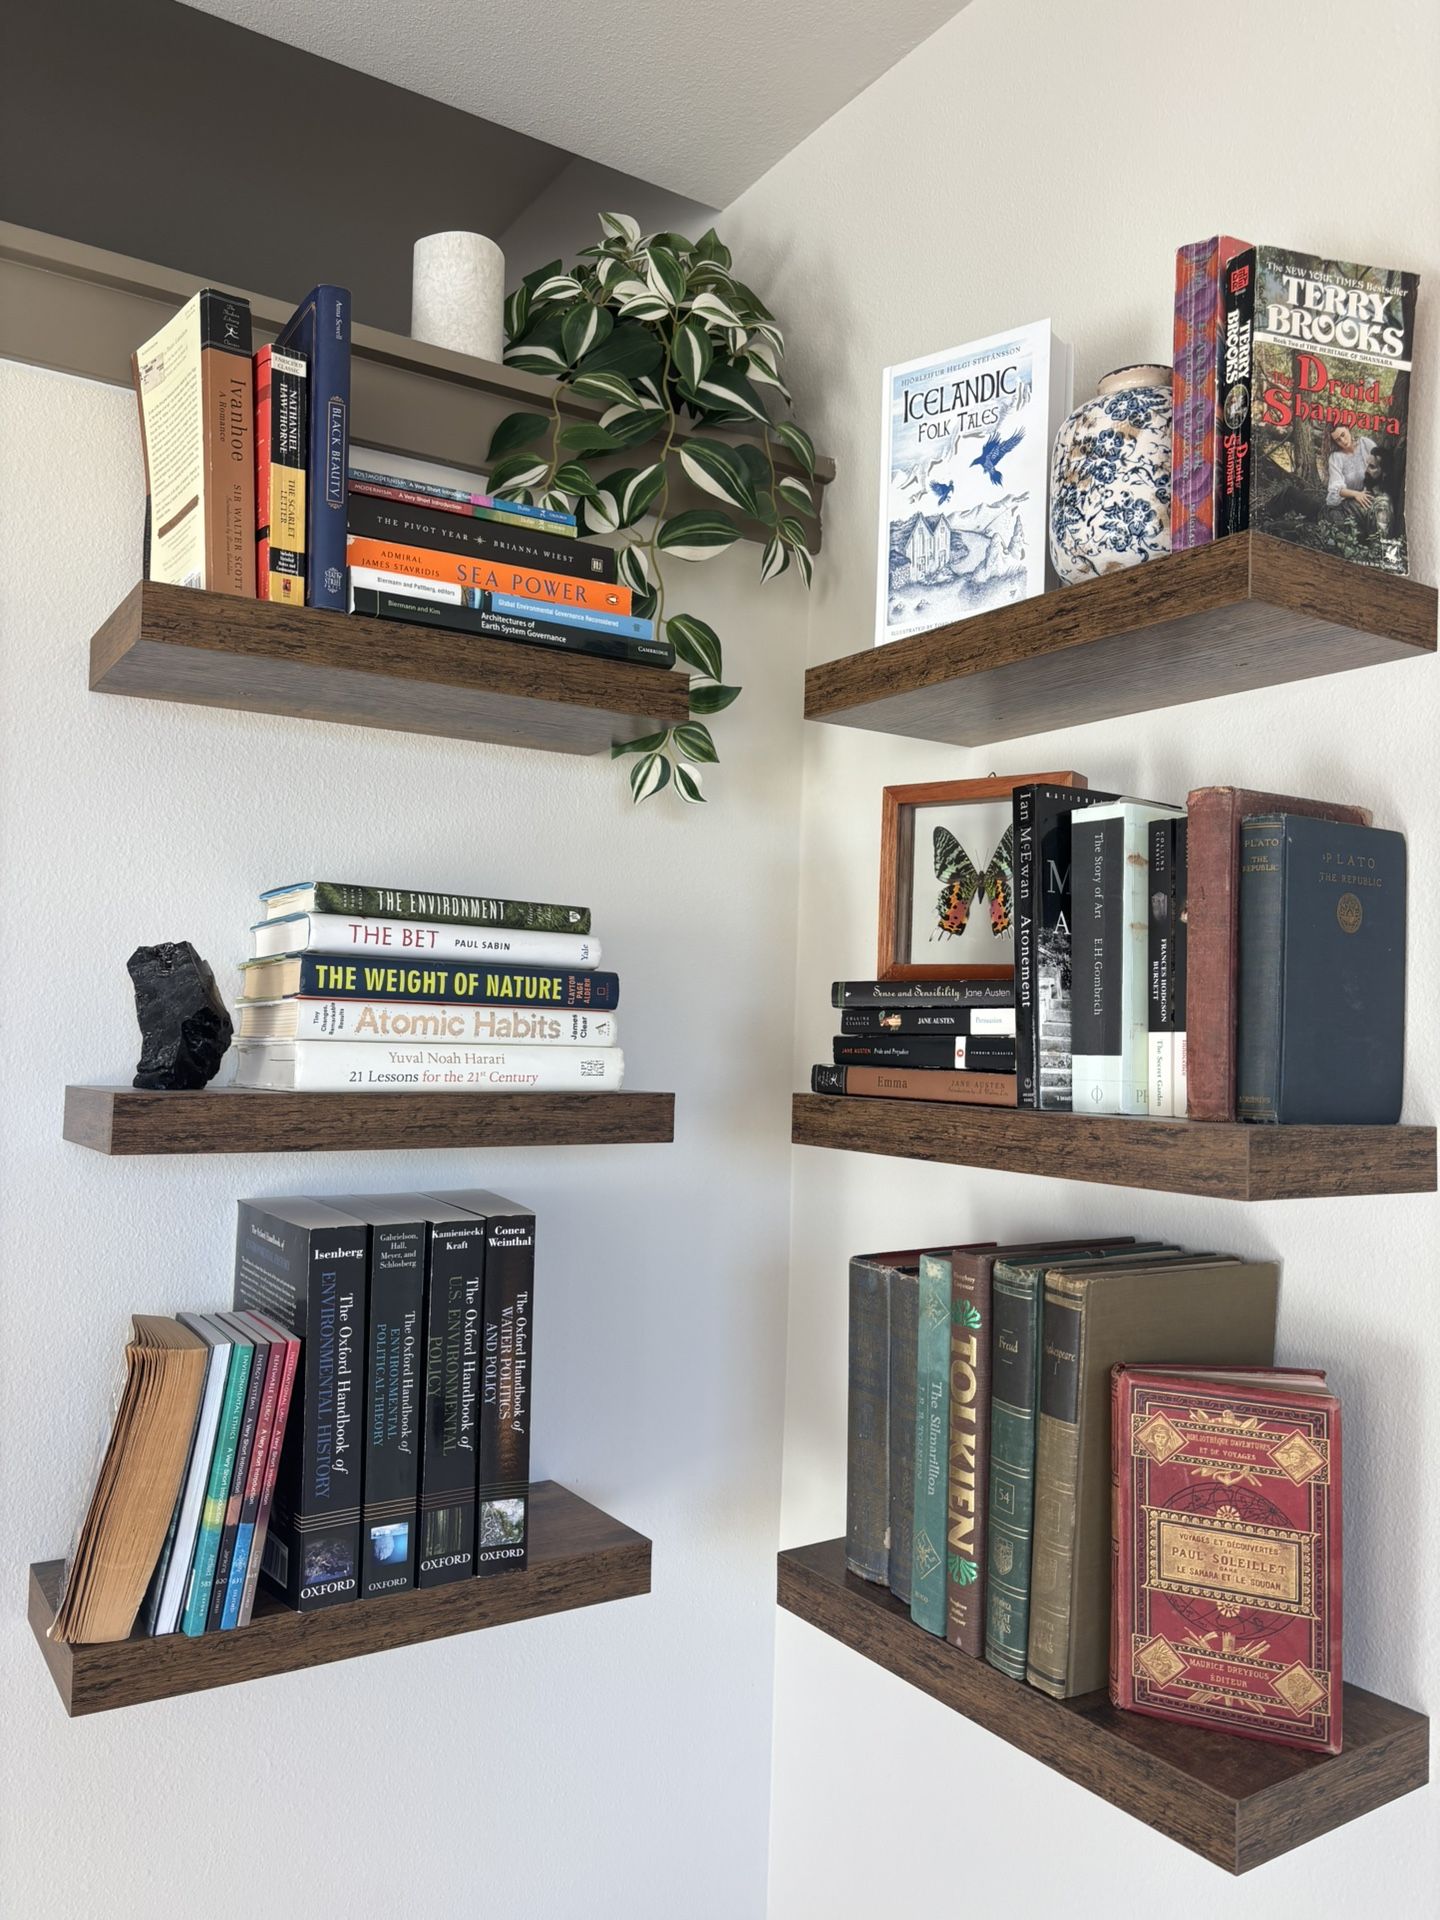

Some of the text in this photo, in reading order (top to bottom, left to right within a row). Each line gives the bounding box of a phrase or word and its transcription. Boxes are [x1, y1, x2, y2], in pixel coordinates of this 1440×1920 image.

[1266, 261, 1409, 297] The NEW YORK TIMES Bestseller
[1282, 274, 1393, 324] TERRY
[335, 300, 343, 340] Anna Sewell
[1265, 304, 1405, 358] BROOKS
[1226, 308, 1240, 385] BROOKS
[1239, 319, 1251, 379] TERRY
[903, 366, 1017, 424] ICELANDIC
[230, 379, 248, 462] Ivanhoe
[279, 382, 288, 454] HAWTHORNE
[289, 389, 298, 452] NATHANIEL
[918, 406, 999, 443] FOLK TALES
[1262, 387, 1401, 436] Shannara
[330, 407, 342, 497] BLACK BEAUTY
[280, 490, 288, 524] LETTER
[287, 480, 296, 538] THE SCARLET
[233, 485, 243, 589] SIR WALTER SCOTT
[377, 516, 469, 542] THE PIVOT YEAR
[381, 550, 422, 563] ADMIRAL
[493, 540, 575, 563] BRIANNA WIEST
[361, 558, 440, 577] JAMES STAVRIDIS
[456, 564, 588, 603] SEA POWER
[387, 600, 417, 611] Biermann
[429, 606, 441, 615] Kim
[481, 612, 525, 627] Architectures
[481, 622, 567, 643] Earth System Governance
[1244, 838, 1280, 848] PLATO
[1242, 864, 1280, 873] REPUBLIC
[1249, 855, 1268, 863] THE
[1326, 852, 1376, 869] PLATO
[1092, 832, 1104, 919] The Story of Art
[1319, 872, 1382, 887] THE REPUBLIC
[377, 890, 505, 920] THE ENVIRONMENT
[1020, 792, 1032, 1007] Ian McEwan Atonement
[348, 924, 439, 949] THE BET
[454, 939, 511, 951] PAUL SABIN
[580, 944, 589, 961] Yale
[315, 964, 563, 1000] THE WEIGHT OF NATURE
[567, 975, 576, 1005] CLAYTON
[576, 982, 584, 999] PAGE
[583, 977, 592, 1004] ALDERN
[872, 984, 960, 1001] Sense and Sensibility
[963, 987, 1011, 999] Jane Austen
[321, 1004, 329, 1032] Changes,
[354, 1006, 562, 1040] Atomic Habits
[580, 1016, 588, 1039] Clear
[917, 1017, 955, 1025] JANE AUSTEN
[388, 1051, 505, 1065] Yuval Noah Harari
[348, 1070, 539, 1086] 21 Lessons for the 21st Century
[877, 1076, 908, 1089] Emma
[951, 1079, 1006, 1090] JANE AUSTEN
[431, 1227, 484, 1239] Kamieniecki
[446, 1240, 469, 1250] Kraft
[488, 1236, 532, 1248] Weinthal
[314, 1247, 364, 1260] Isenberg
[380, 1260, 417, 1269] Schlosberg
[381, 1250, 417, 1260] Meyer, and
[999, 1335, 1018, 1353] Freud
[428, 1336, 443, 1396] POLICY
[457, 1277, 480, 1451] The Oxford Handbook of
[484, 1322, 498, 1405] AND POLICY
[499, 1306, 514, 1420] WATER POLITICS
[510, 1291, 528, 1434] The Oxford Handbook of
[315, 1271, 337, 1499] ENVIRONMENTAL HISTORY
[331, 1292, 354, 1475] The Oxford Handbook of
[373, 1322, 387, 1447] POLITICAL THEORY
[387, 1328, 401, 1440] ENVIRONMENTAL
[398, 1310, 416, 1454] The Oxford Handbook of
[927, 1382, 943, 1496] The Silmarillion
[947, 1334, 977, 1556] TOLKIEN
[1222, 1450, 1257, 1461] VOYAGES
[998, 1489, 1010, 1505] 54
[420, 1552, 472, 1572] OXFORD
[480, 1548, 525, 1562] OXFORD
[1172, 1546, 1287, 1575] PAUL SOLEILLET
[300, 1578, 356, 1600] OXFORD
[368, 1576, 408, 1592] OXFORD
[1189, 1658, 1270, 1681] MAURICE DREYFOUS
